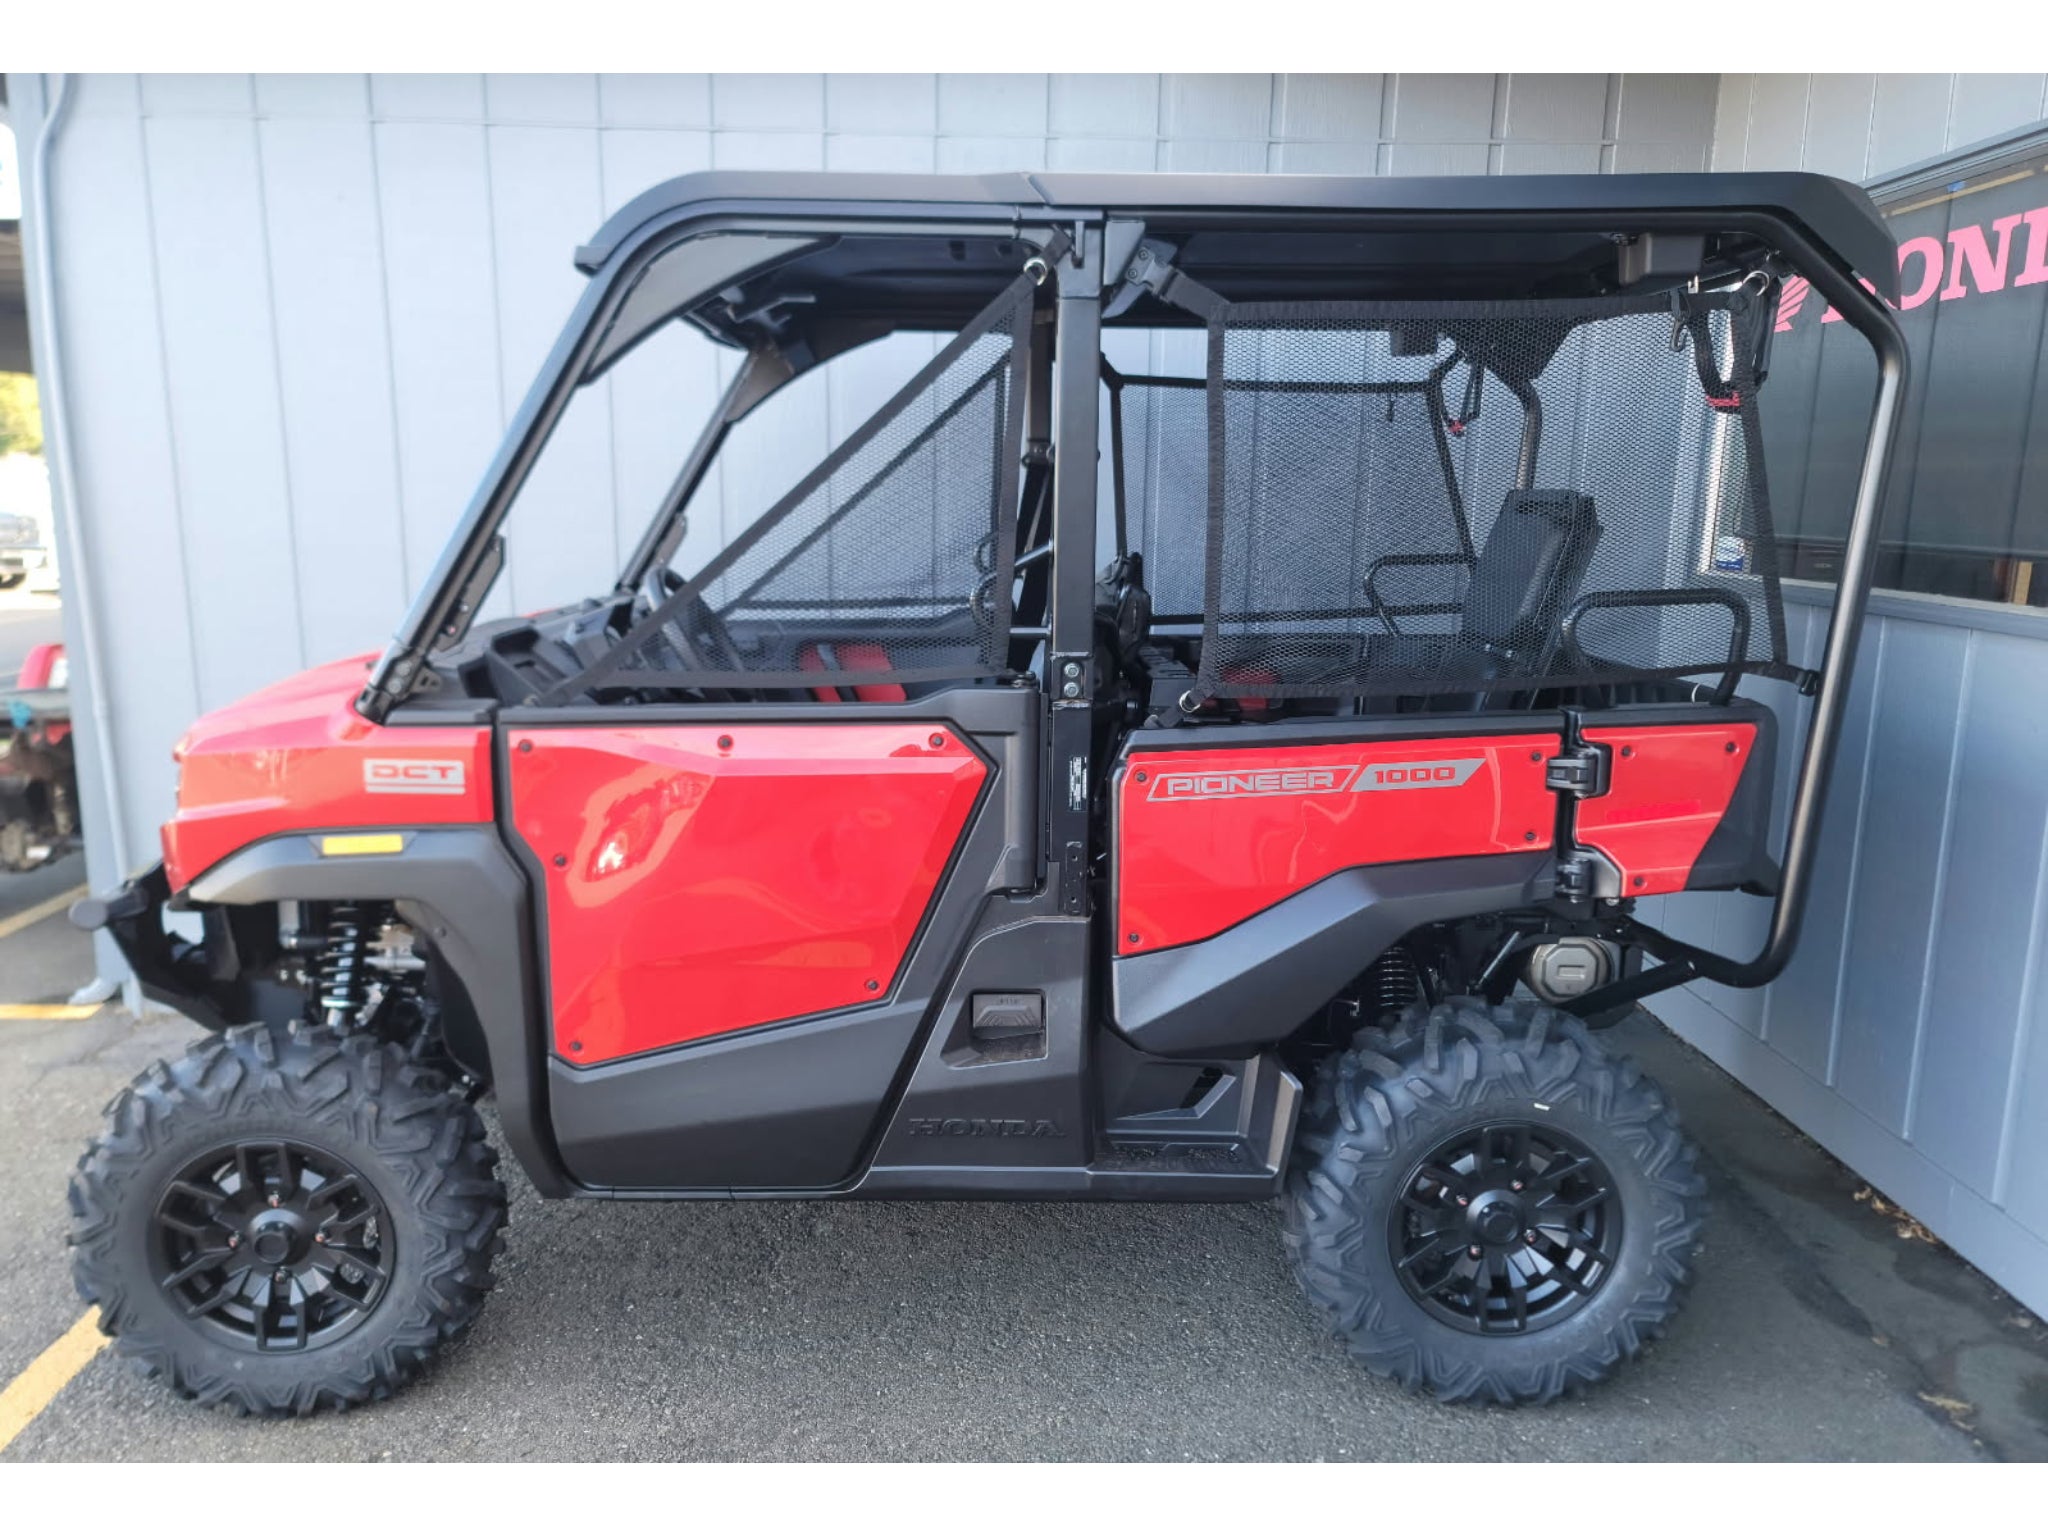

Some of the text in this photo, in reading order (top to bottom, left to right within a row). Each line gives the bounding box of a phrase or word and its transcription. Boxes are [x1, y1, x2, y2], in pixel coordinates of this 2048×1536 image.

[373, 764, 455, 779] DCT
[1167, 766, 1456, 796] PIONEER 1000
[907, 1117, 1064, 1137] HONDA
